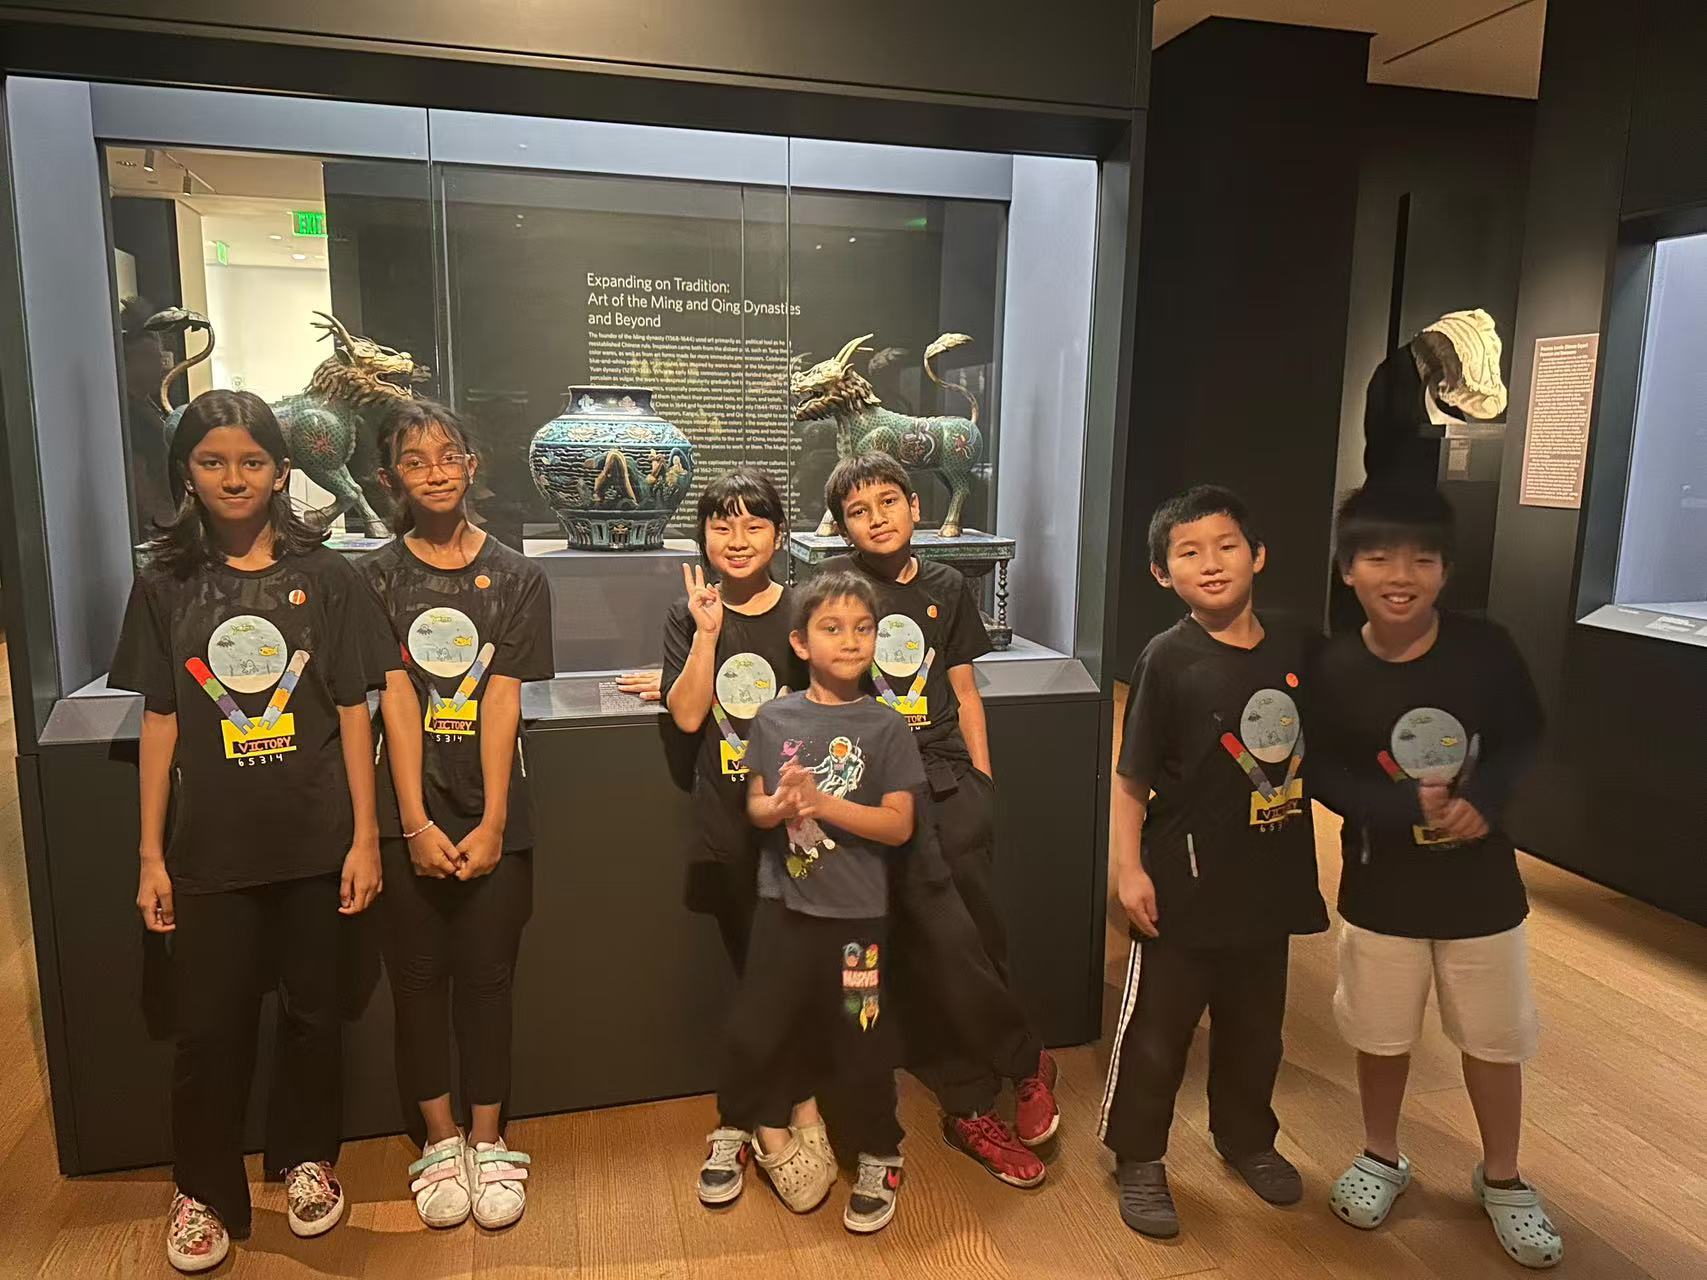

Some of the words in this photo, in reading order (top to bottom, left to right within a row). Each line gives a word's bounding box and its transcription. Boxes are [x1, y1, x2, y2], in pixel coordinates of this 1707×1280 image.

[587, 273, 652, 291] Expanding
[655, 280, 671, 290] on
[674, 277, 730, 294] Tradition:
[588, 292, 608, 306] Art
[611, 294, 624, 306] of
[627, 295, 648, 308] the
[651, 296, 683, 312] Ming
[686, 298, 709, 311] and
[711, 298, 741, 315] Qing
[744, 300, 801, 316] Dynasties
[588, 312, 612, 325] and
[615, 313, 661, 329] Beyond
[237, 736, 292, 754] VICTORY
